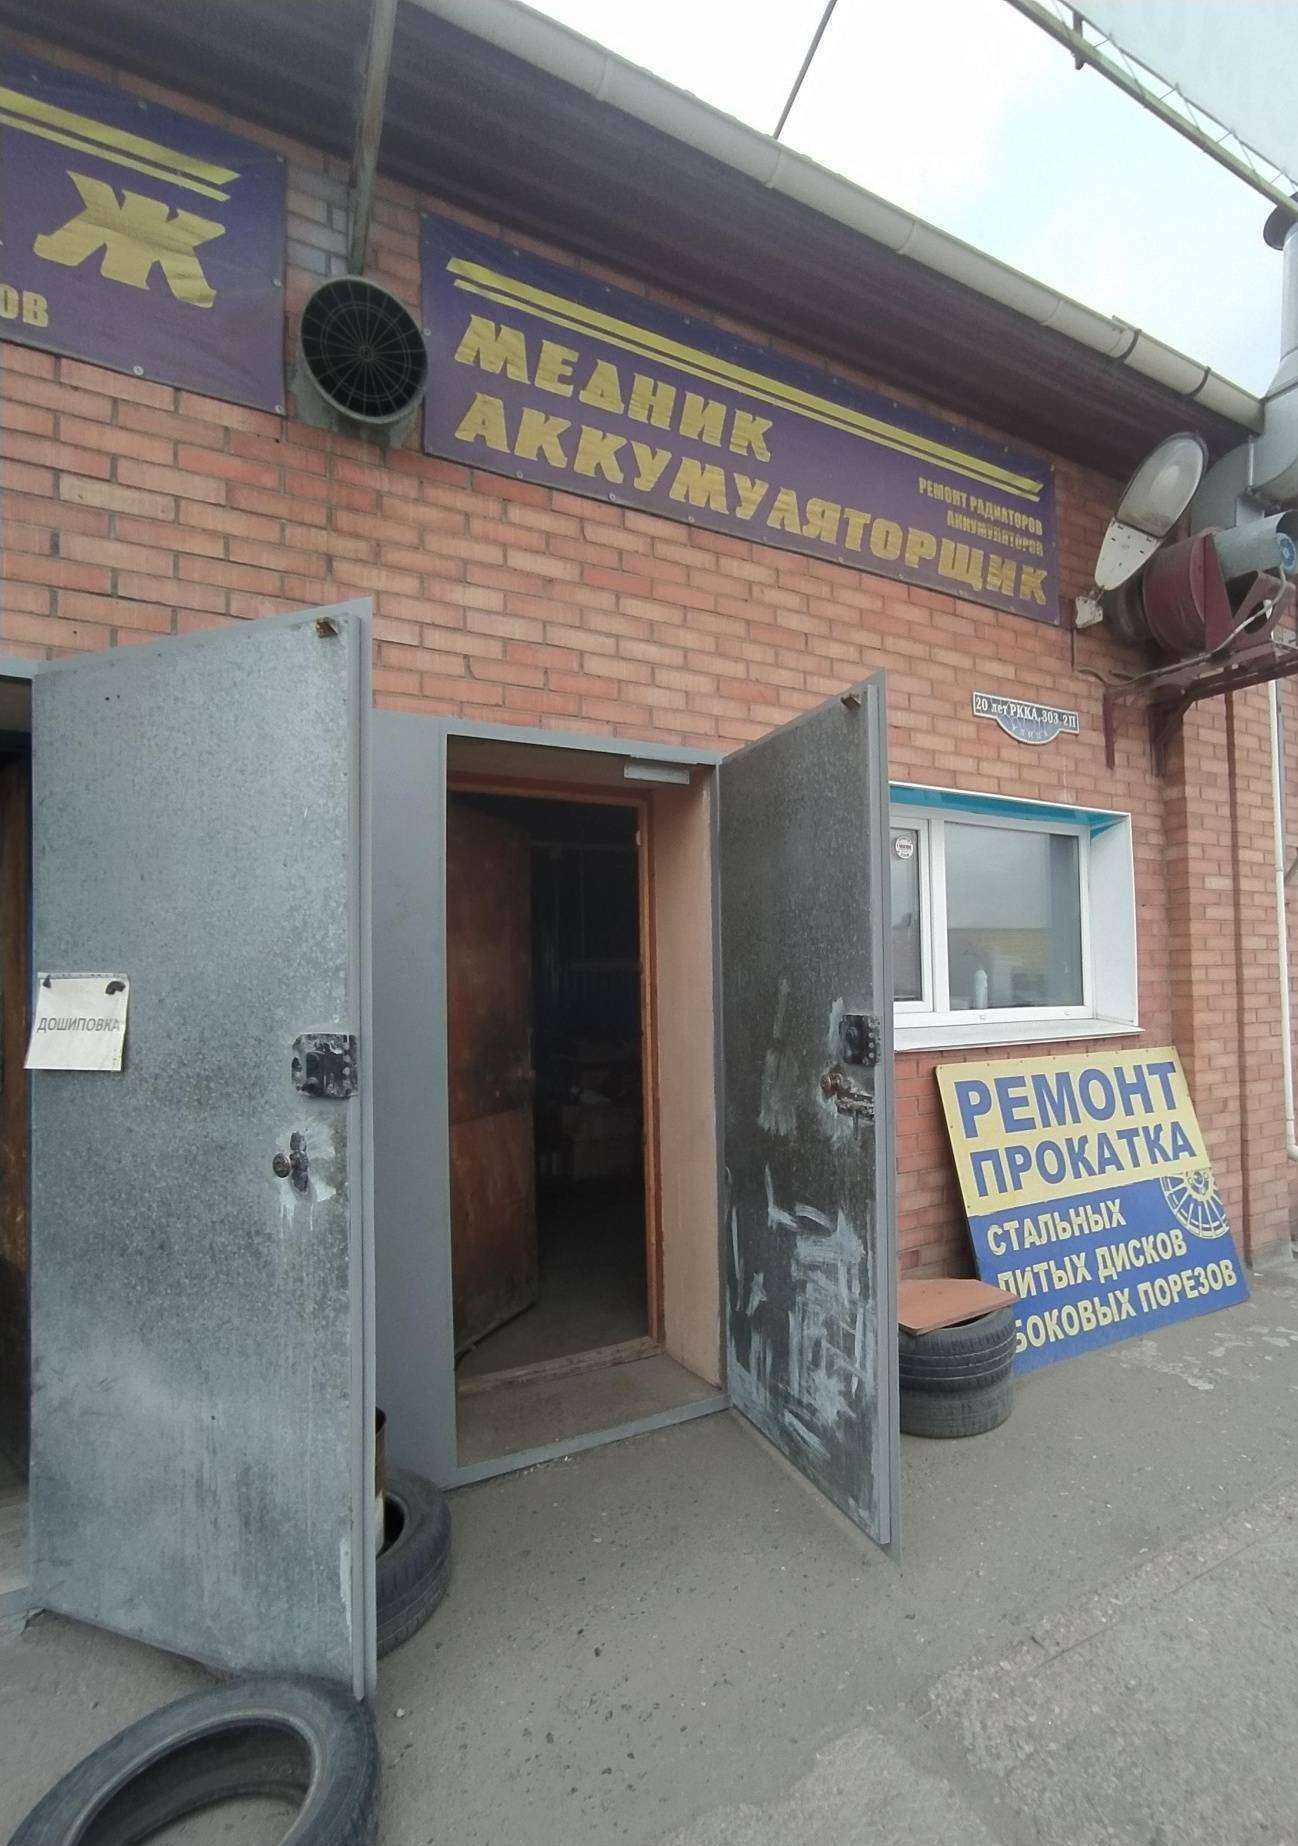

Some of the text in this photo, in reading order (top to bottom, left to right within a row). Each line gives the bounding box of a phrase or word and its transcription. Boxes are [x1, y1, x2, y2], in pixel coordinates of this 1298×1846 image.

[453, 314, 773, 463] МЕДНИК
[455, 393, 1048, 606] АККУМУЛЯТОРЩИК
[918, 477, 1043, 536] РЕМОНТ РАДИАТОРОВ
[975, 696, 988, 711] 20
[990, 703, 1008, 715] лет
[1041, 709, 1059, 725] 303
[37, 1017, 121, 1033] ДОШИПОВКА
[954, 1061, 1177, 1139] РЕМОНТ
[969, 1120, 1197, 1198] ПРОКАТКА
[986, 1198, 1127, 1256] СТАЛЬНЫХ
[1096, 1228, 1188, 1284] ДИСКОВ
[1138, 1259, 1238, 1313] ПОРЕЗОВ
